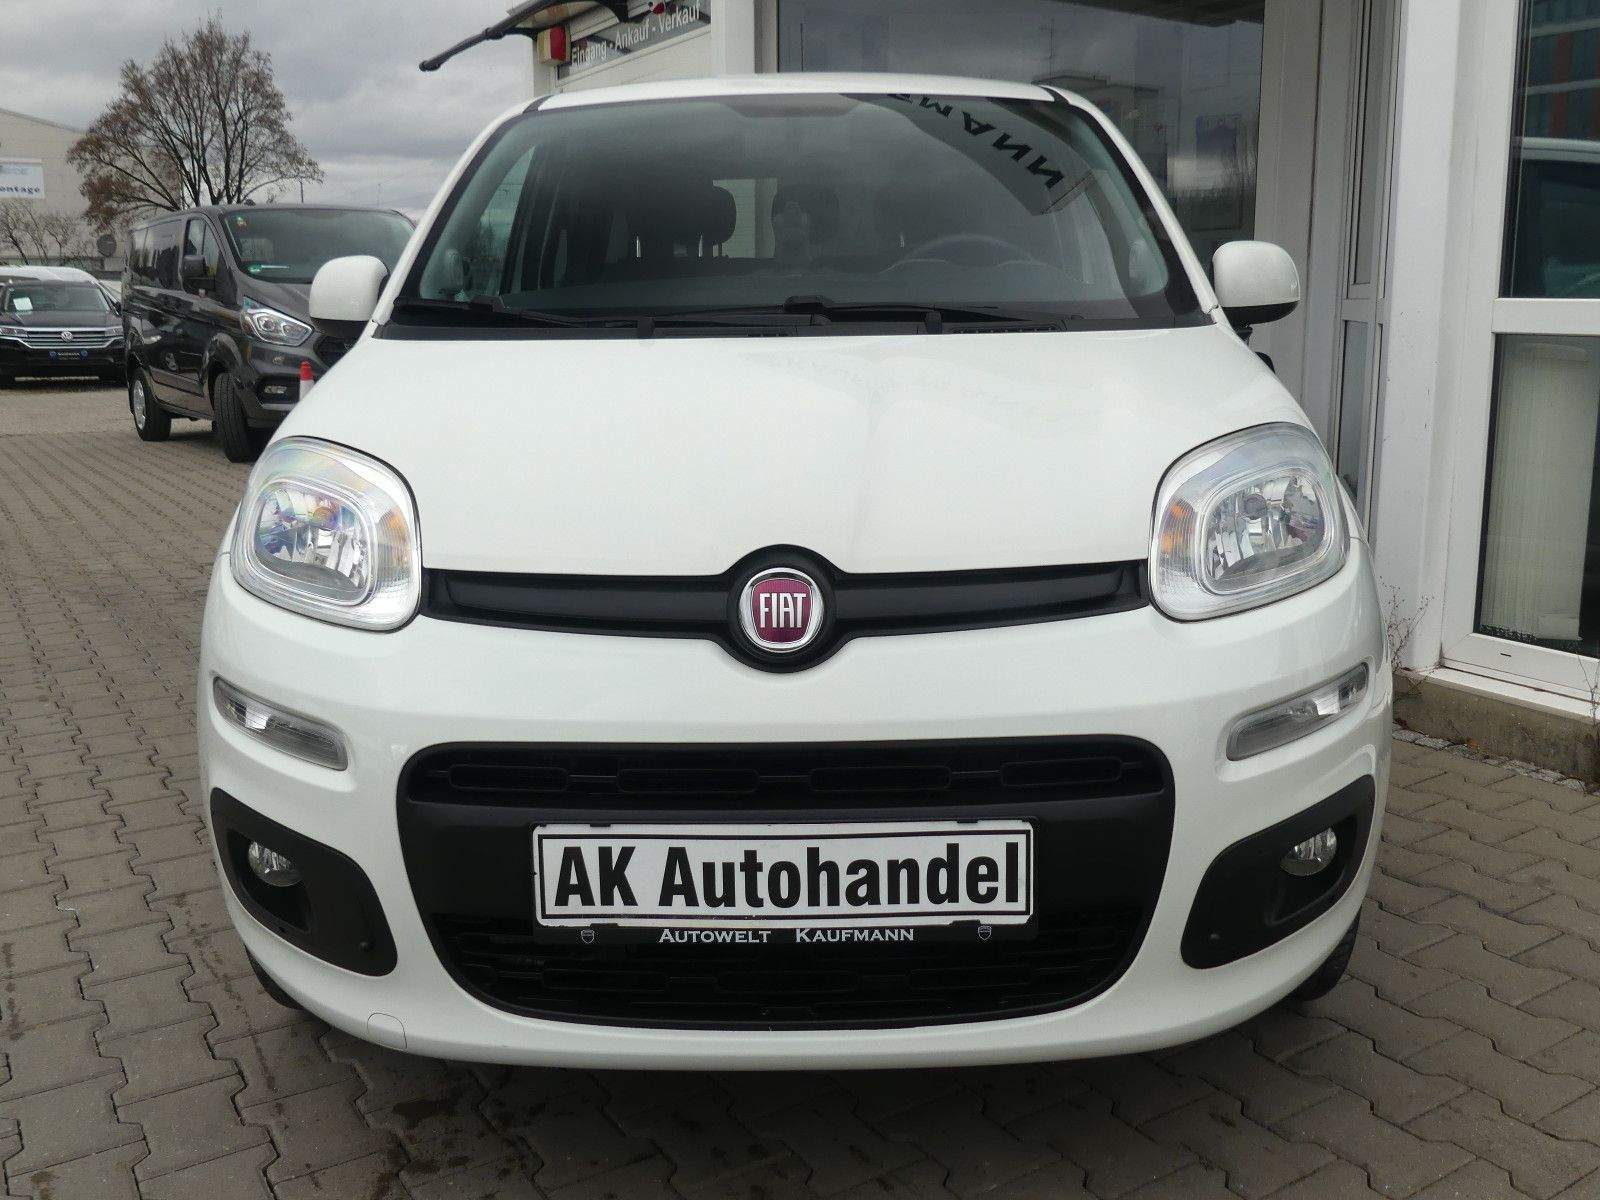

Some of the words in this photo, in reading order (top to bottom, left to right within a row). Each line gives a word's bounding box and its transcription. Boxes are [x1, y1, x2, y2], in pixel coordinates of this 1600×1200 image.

[571, 39, 607, 67] Eingang
[615, 20, 650, 51] Ankauf
[658, 1, 701, 34] Verkauf
[759, 593, 807, 628] FIAT
[554, 846, 639, 907] AK
[658, 841, 1019, 909] Autohandel
[658, 928, 772, 944] AUTOWELT
[796, 928, 915, 943] KAUFMANN
